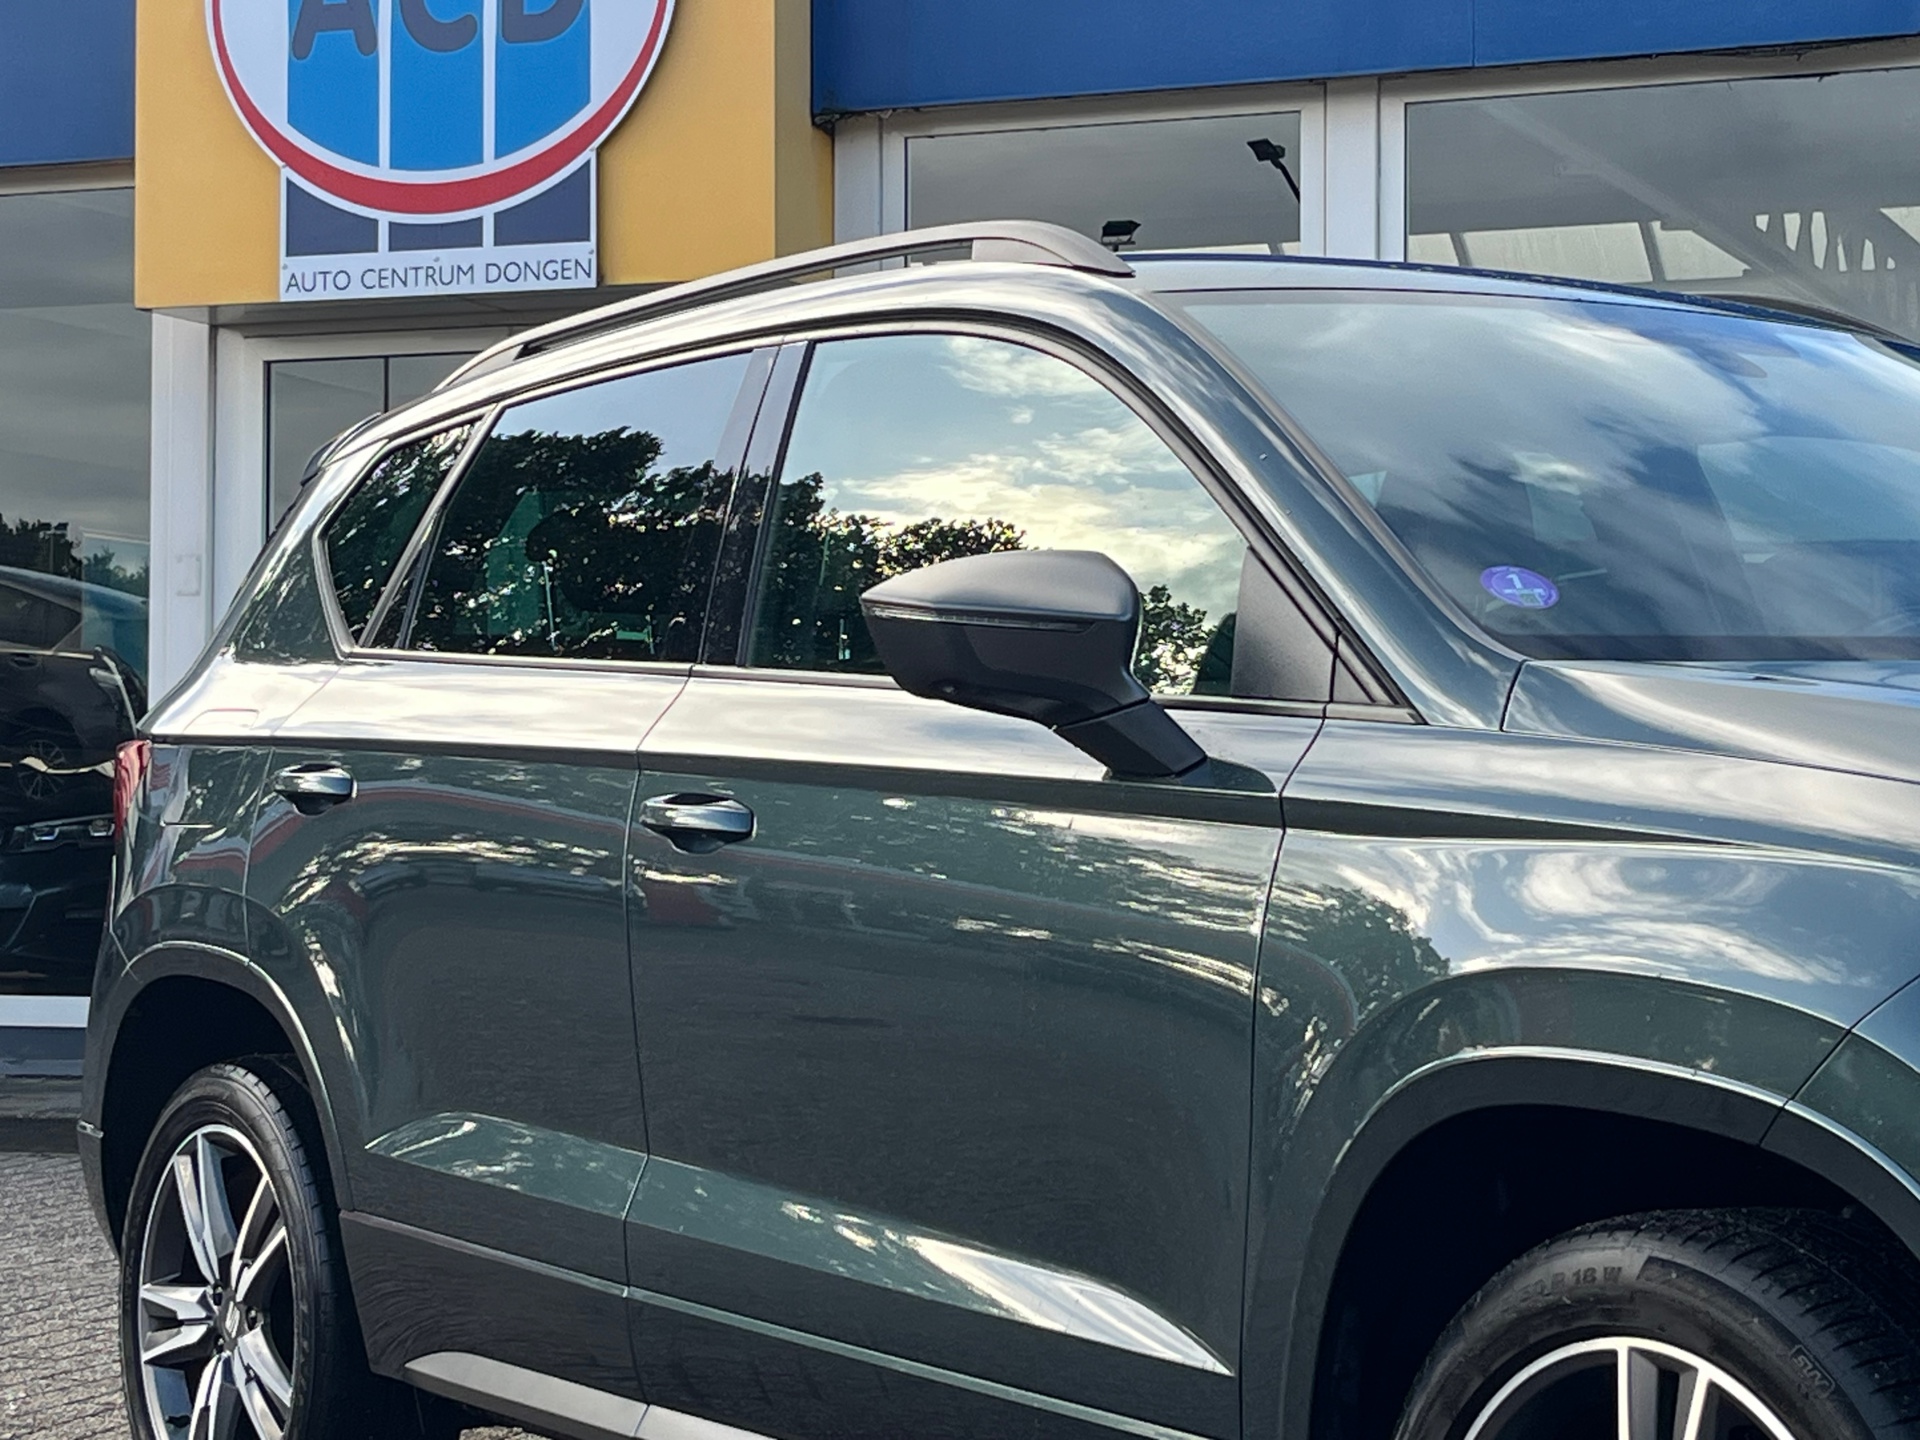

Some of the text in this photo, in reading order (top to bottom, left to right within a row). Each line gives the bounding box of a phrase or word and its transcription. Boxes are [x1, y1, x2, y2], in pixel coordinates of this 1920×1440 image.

[285, 257, 592, 294] AUTO CENTRUM DONGEN
